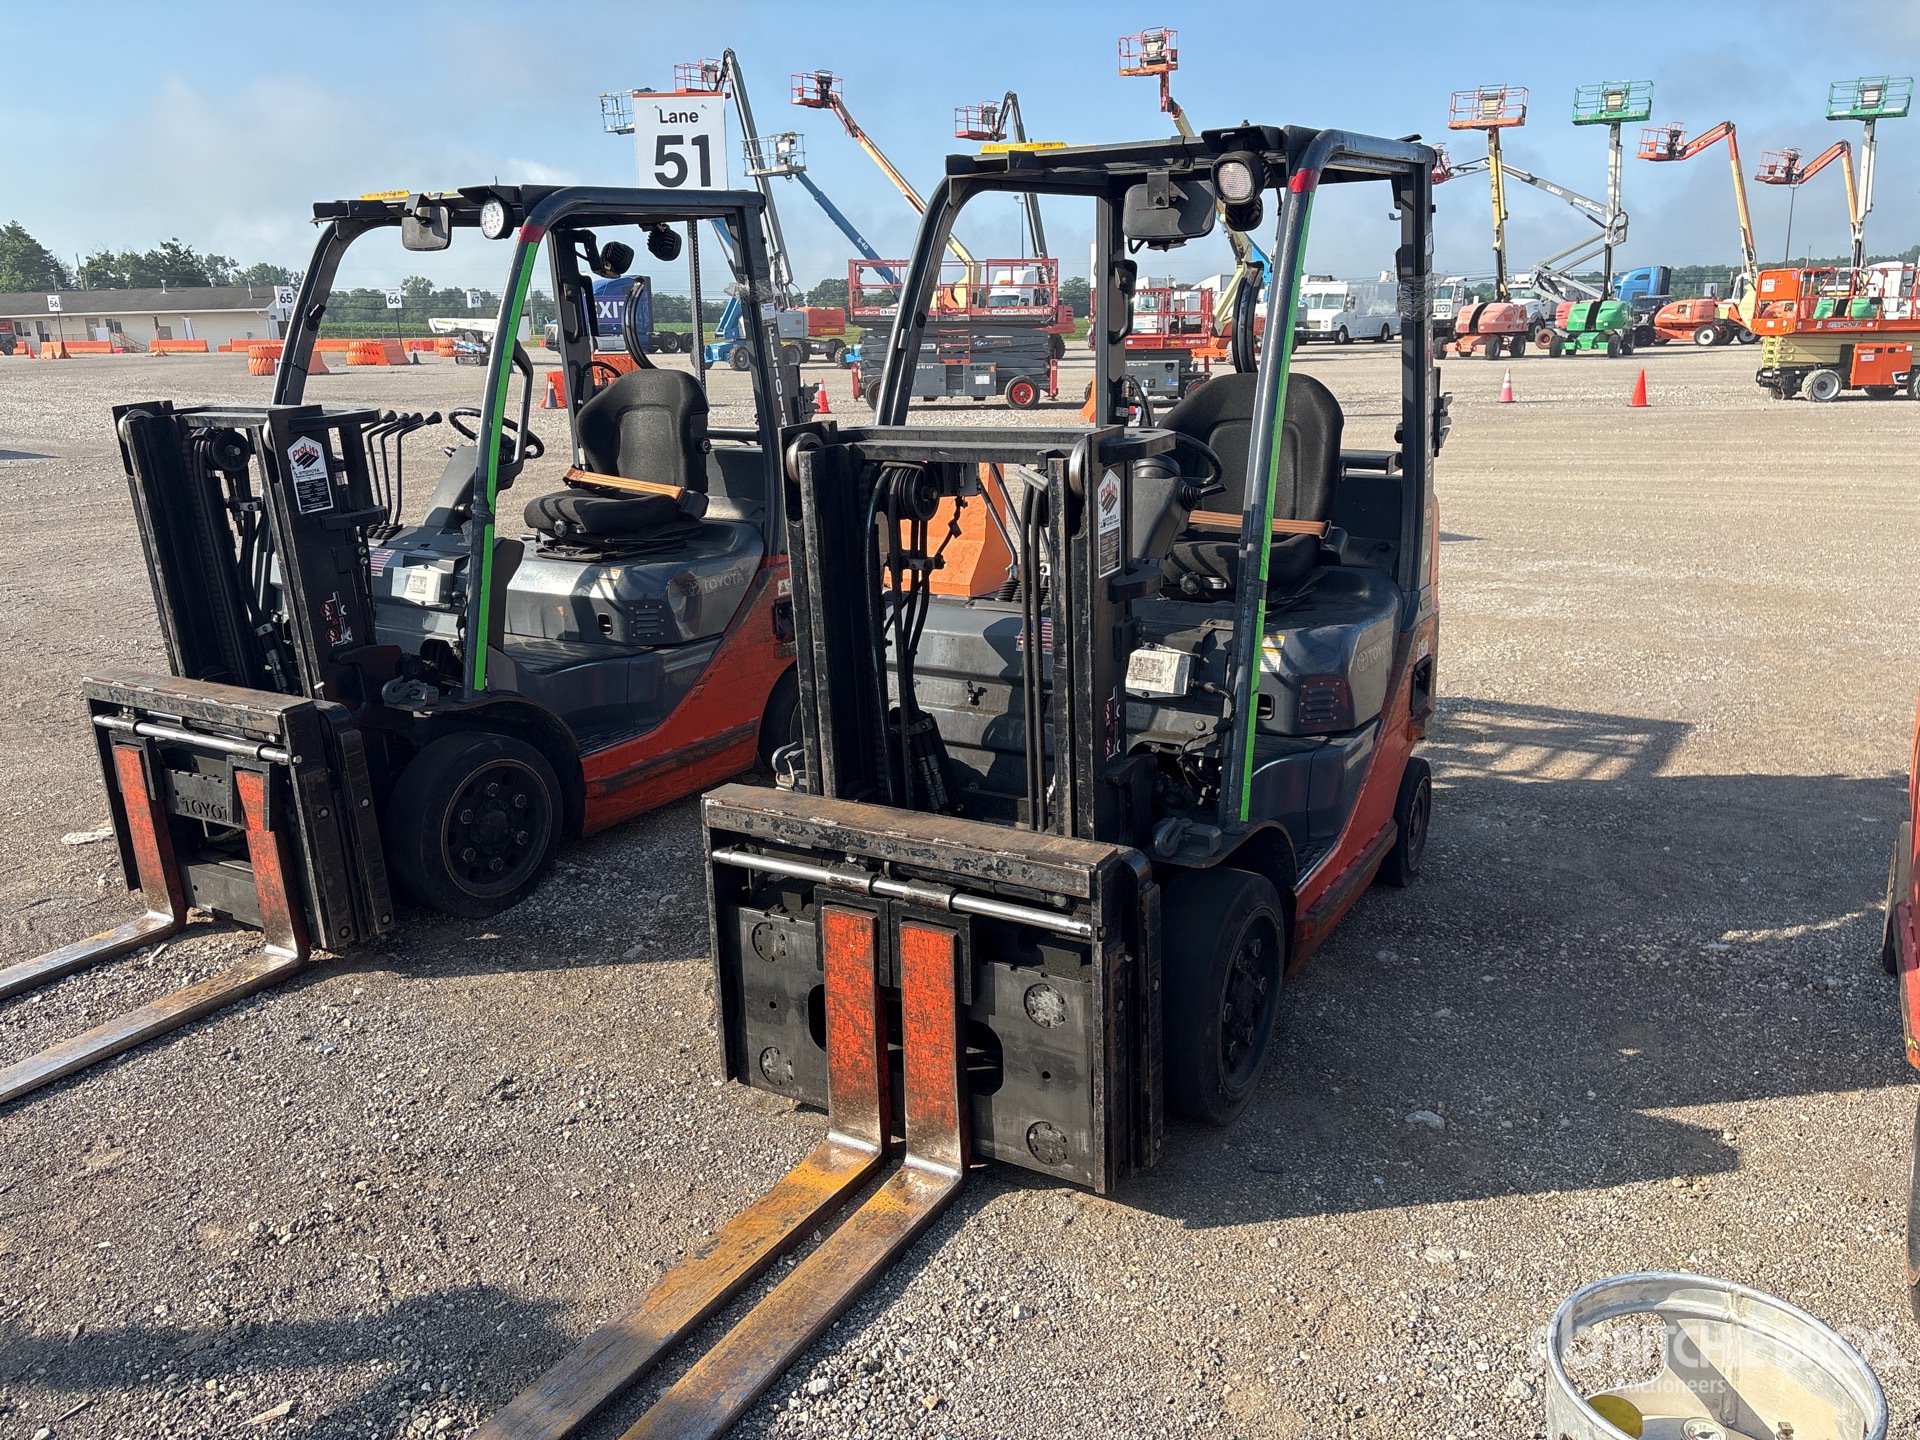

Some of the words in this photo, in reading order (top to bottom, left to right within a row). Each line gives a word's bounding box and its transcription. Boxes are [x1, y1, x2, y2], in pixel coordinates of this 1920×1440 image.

[659, 108, 699, 124] Lane
[654, 134, 712, 188] 51
[1572, 197, 1603, 214] SKYJACK
[49, 300, 59, 308] 56
[279, 293, 293, 304] 65
[387, 295, 400, 305] 66
[471, 296, 480, 305] 67
[292, 443, 319, 460] ProLift
[704, 573, 744, 591] TOYOTA
[181, 797, 228, 821] TOYOT
